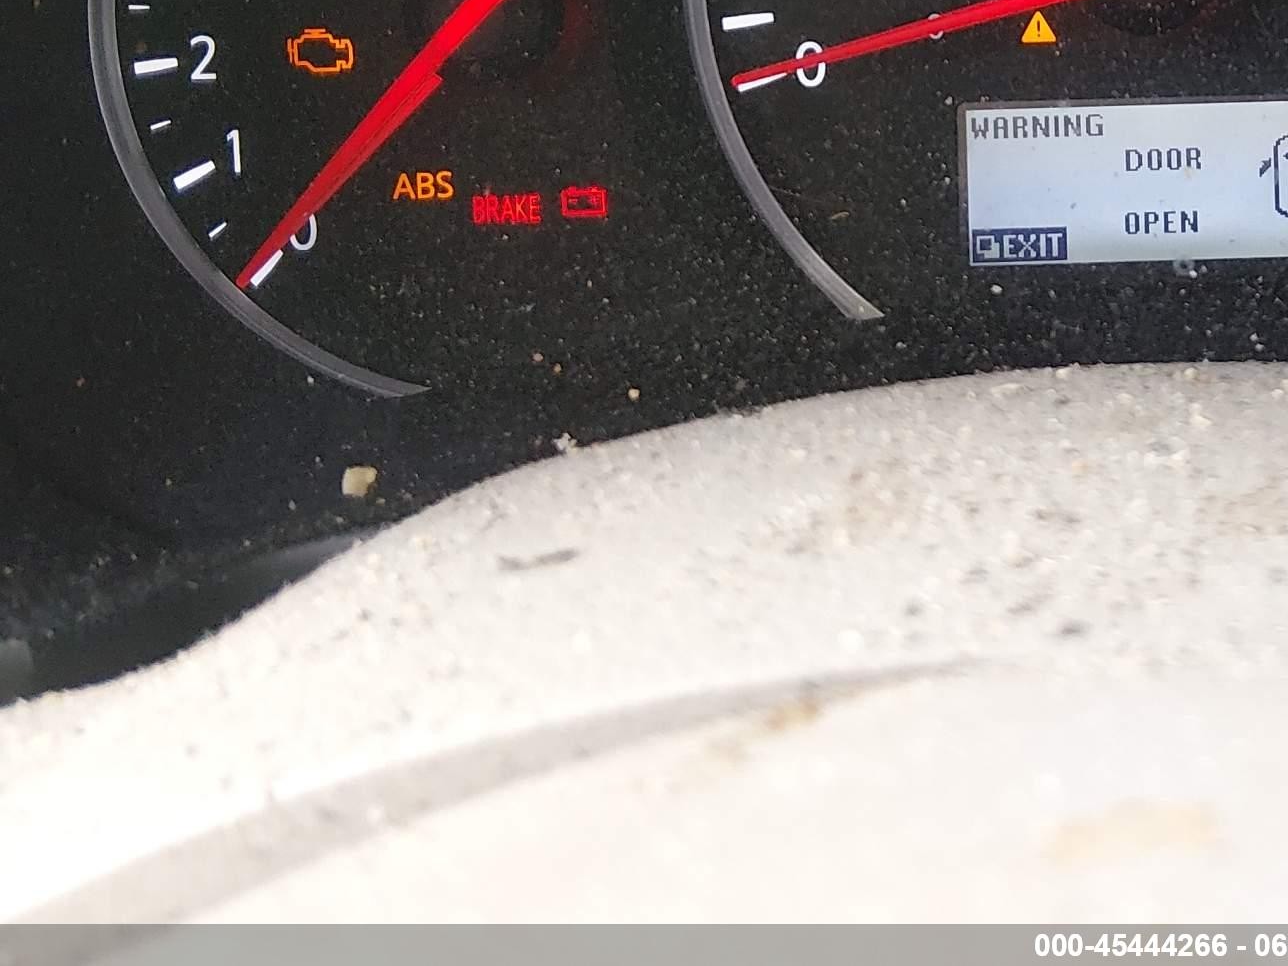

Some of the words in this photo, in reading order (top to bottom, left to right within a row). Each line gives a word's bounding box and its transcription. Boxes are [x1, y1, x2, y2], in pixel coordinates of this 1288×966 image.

[190, 35, 217, 81] 2
[795, 40, 827, 88] 0
[971, 113, 1105, 139] WARNING
[226, 130, 242, 175] 1
[1124, 147, 1202, 172] DOOR
[393, 170, 454, 201] ABS
[472, 193, 542, 225] BRAKE
[1124, 210, 1200, 235] OPEN
[1003, 233, 1064, 259] EXIT
